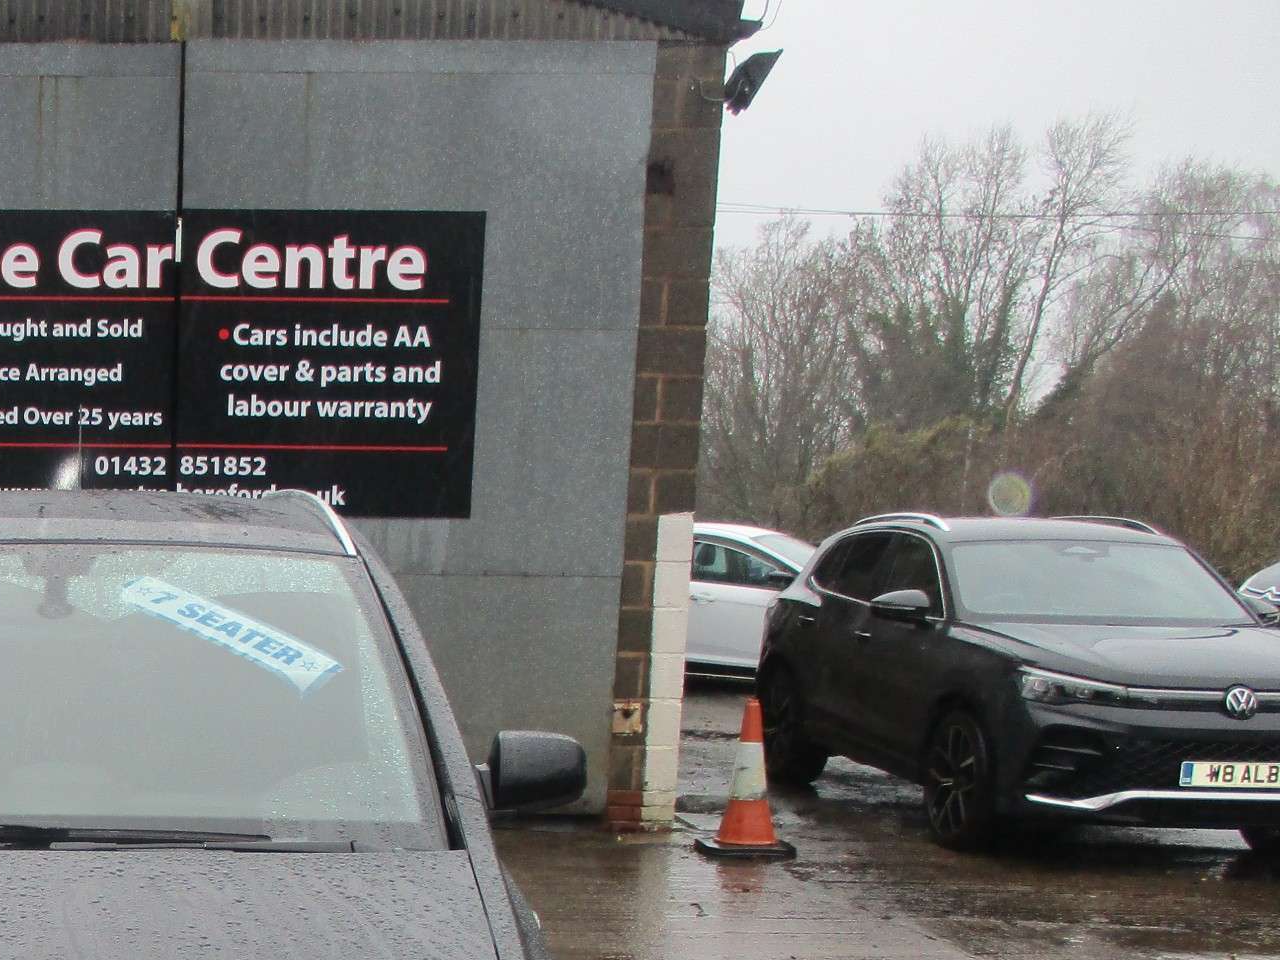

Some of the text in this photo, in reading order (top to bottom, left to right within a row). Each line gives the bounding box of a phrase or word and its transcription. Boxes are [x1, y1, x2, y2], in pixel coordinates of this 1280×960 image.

[57, 230, 174, 290] Car
[195, 229, 427, 291] Centre
[52, 318, 93, 339] and
[96, 318, 144, 339] Sold
[232, 323, 432, 348] Cars include AA
[25, 362, 123, 386] Arranged
[219, 360, 442, 388] cover & parts and
[23, 406, 75, 427] Over
[78, 407, 104, 427] 25
[107, 411, 164, 431] years
[226, 394, 434, 425] labour warranty
[94, 455, 267, 476] 01432 851852
[149, 591, 304, 665] 7 SEATER
